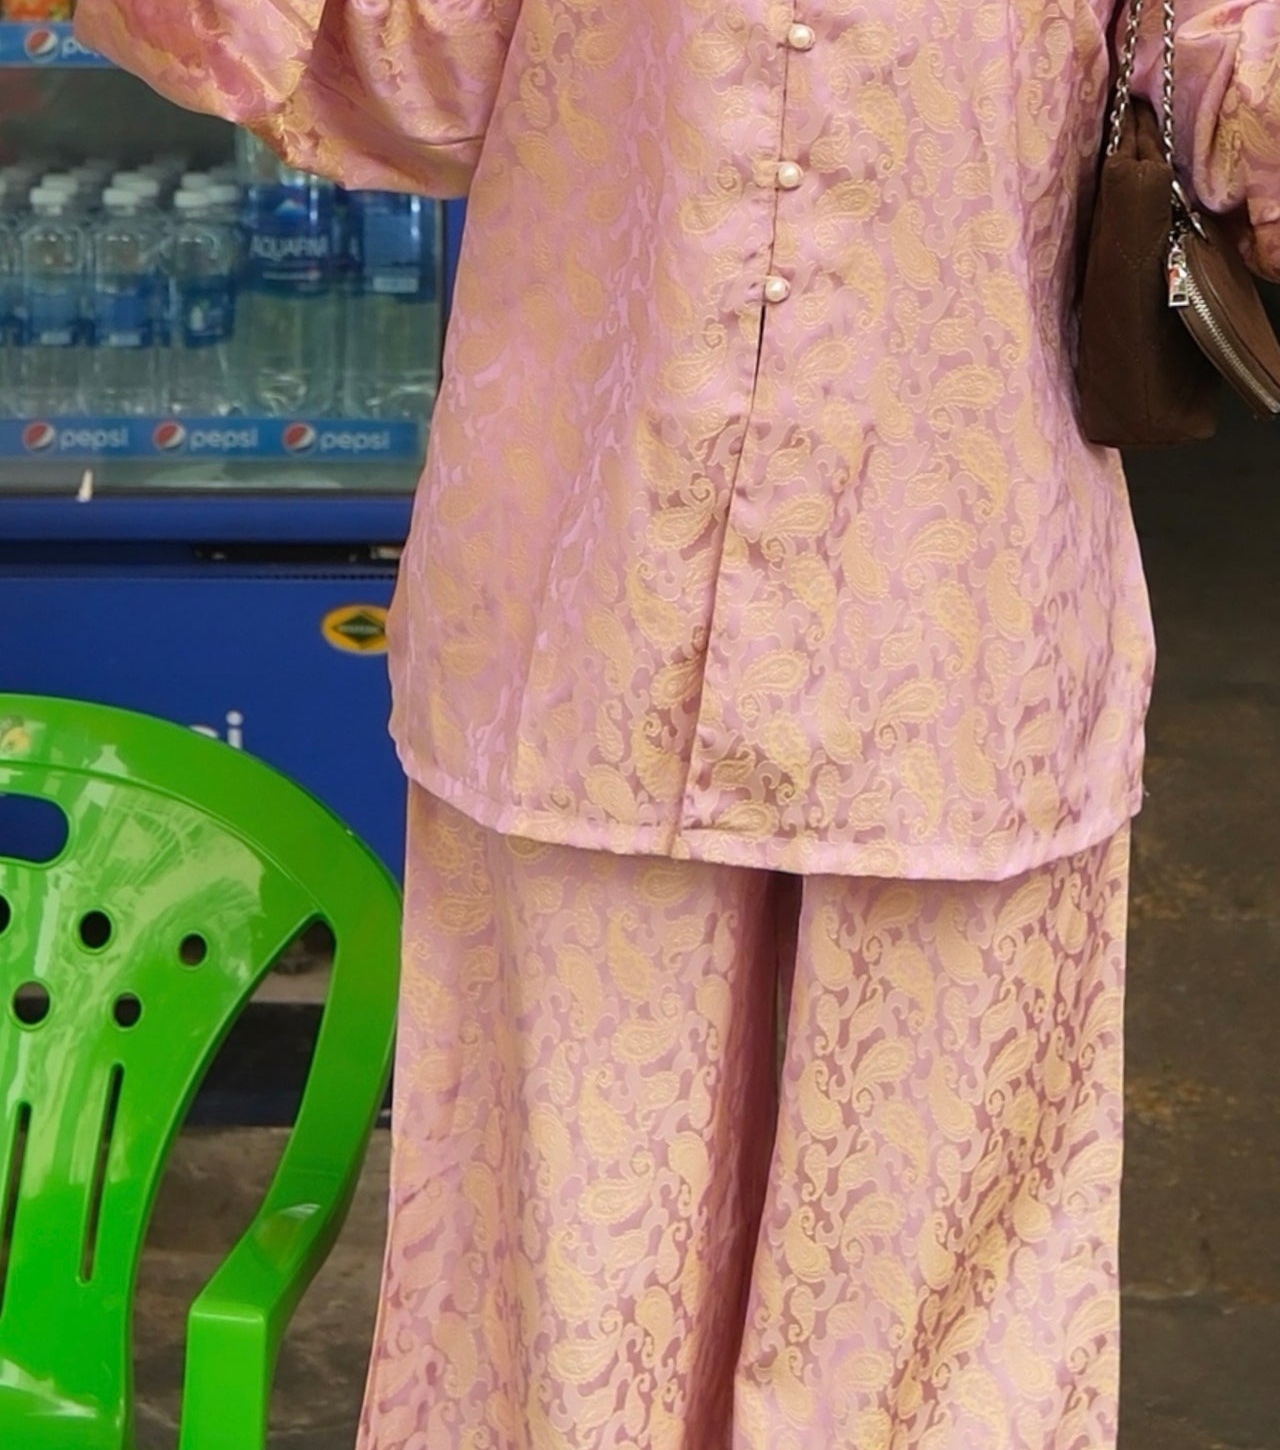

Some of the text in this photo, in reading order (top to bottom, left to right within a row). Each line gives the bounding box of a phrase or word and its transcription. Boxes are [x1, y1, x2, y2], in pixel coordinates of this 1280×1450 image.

[59, 427, 129, 451] pepsi
[189, 428, 259, 451] pepsi
[319, 429, 391, 453] pepsi
